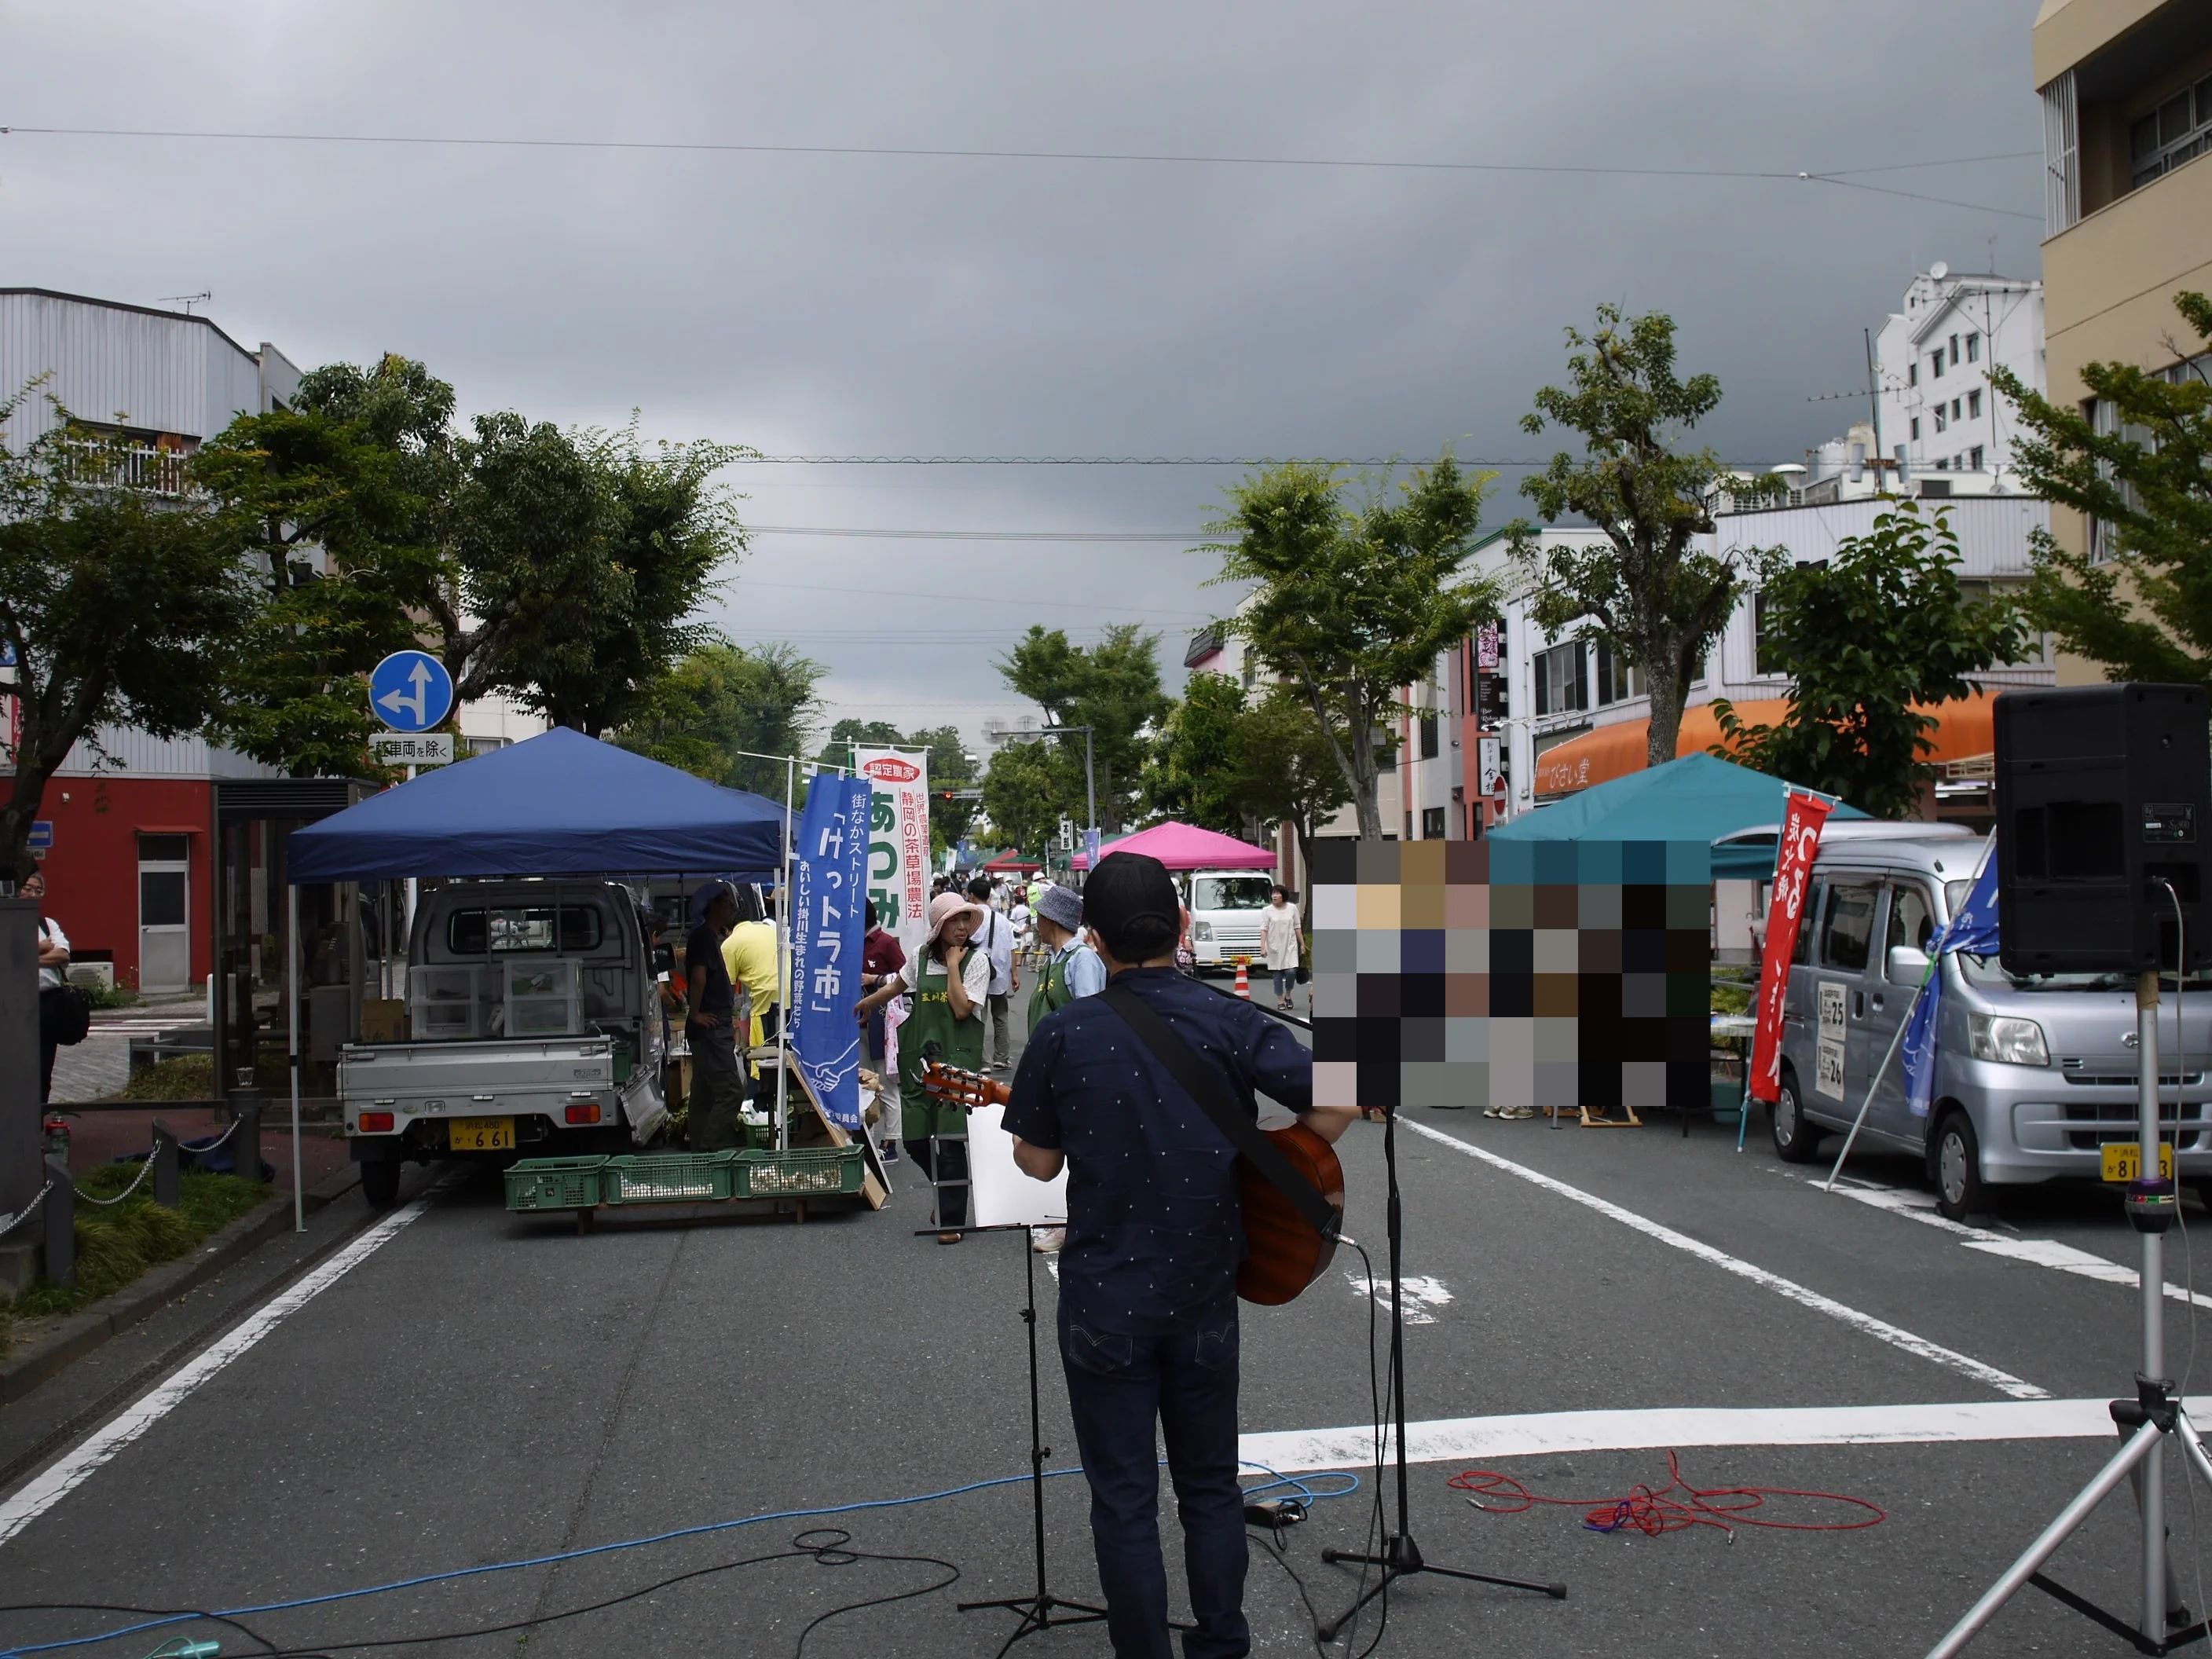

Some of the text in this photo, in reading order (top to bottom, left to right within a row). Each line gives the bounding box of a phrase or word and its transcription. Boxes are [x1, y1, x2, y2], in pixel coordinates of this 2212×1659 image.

[848, 793, 867, 918] 街なかストリート
[901, 792, 923, 919] 静岡の茶草場農法
[794, 860, 811, 1029] おいしい掛川生まれの野菜たち
[1831, 1001, 1844, 1026] 25
[1830, 1060, 1842, 1085] 26
[2119, 1159, 2168, 1177] 813
